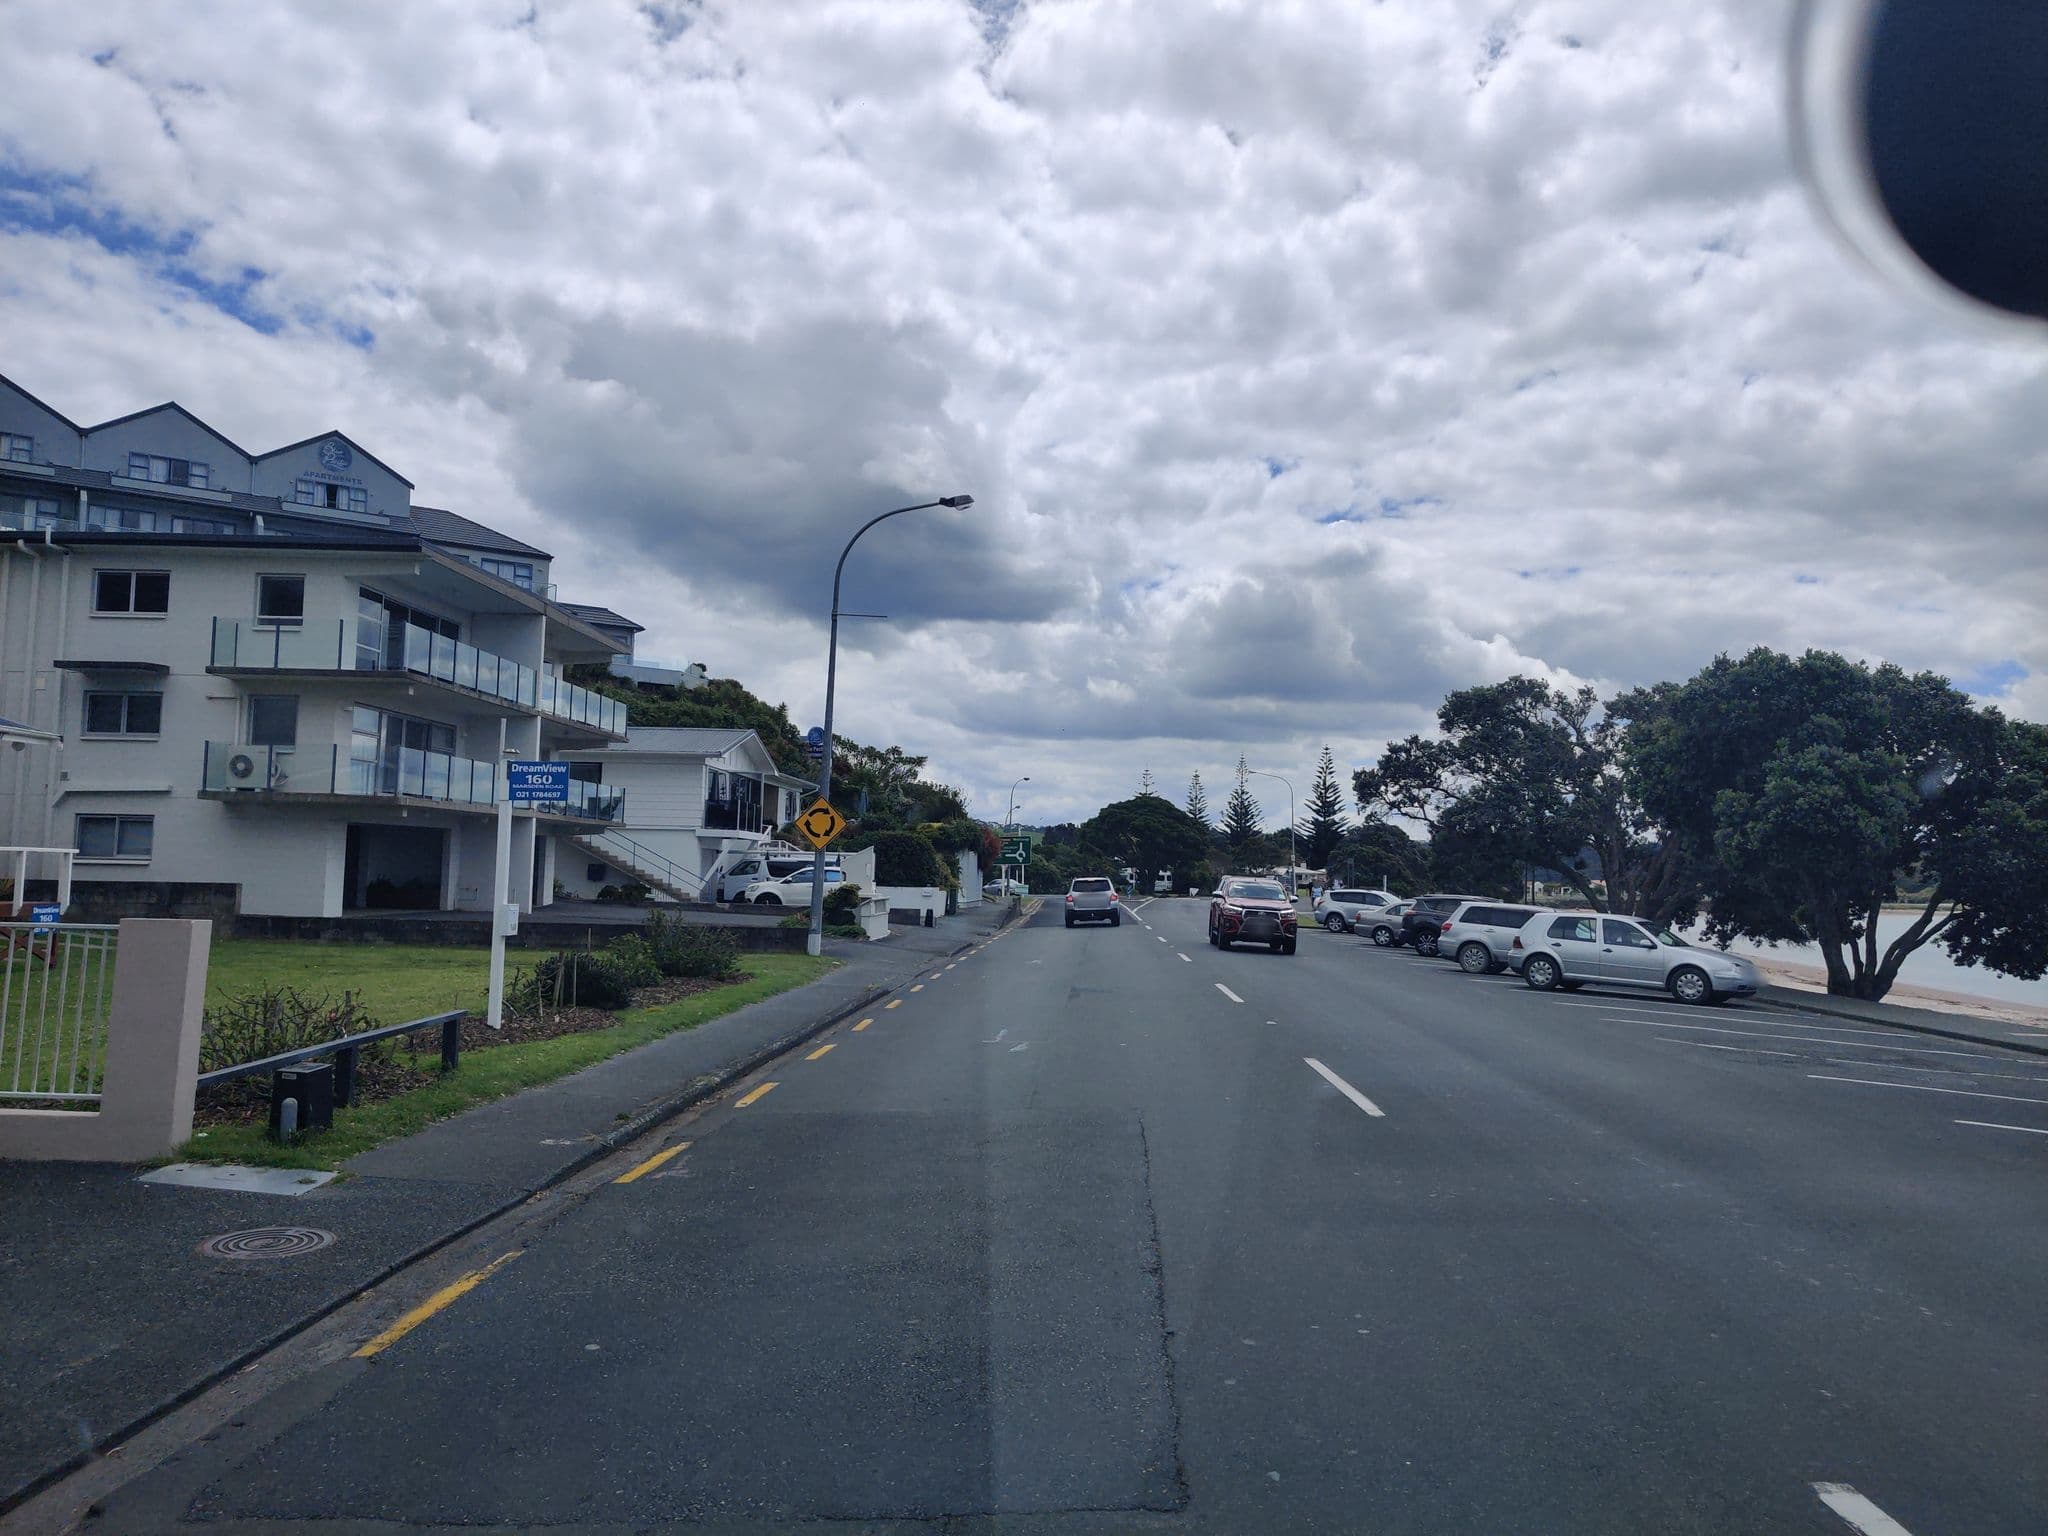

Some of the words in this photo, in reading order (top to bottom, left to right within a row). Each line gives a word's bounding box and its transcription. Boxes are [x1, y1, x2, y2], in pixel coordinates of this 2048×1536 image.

[303, 471, 363, 485] APARTMENTS
[511, 763, 567, 773] DreamView
[525, 774, 553, 784] 160
